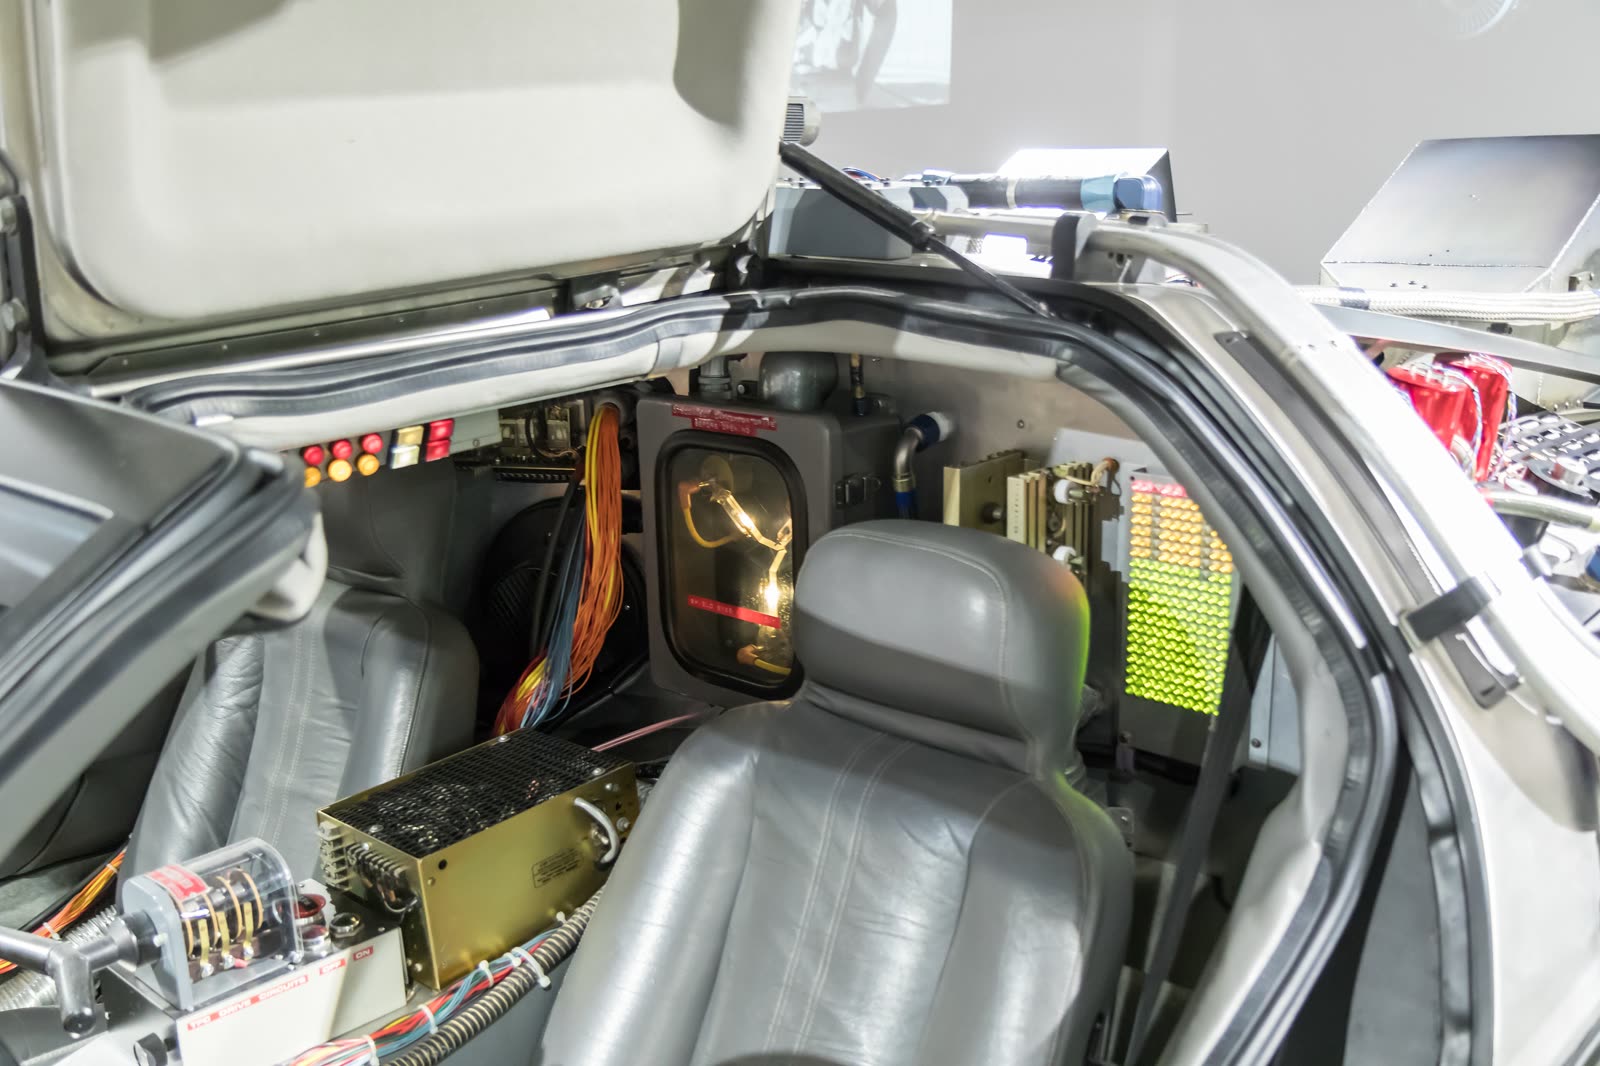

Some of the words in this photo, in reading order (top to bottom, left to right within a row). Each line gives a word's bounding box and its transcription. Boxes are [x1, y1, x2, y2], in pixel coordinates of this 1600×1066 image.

[355, 948, 371, 960] ON
[218, 999, 252, 1018] DRIVE
[258, 976, 307, 1000] CIRCUITS
